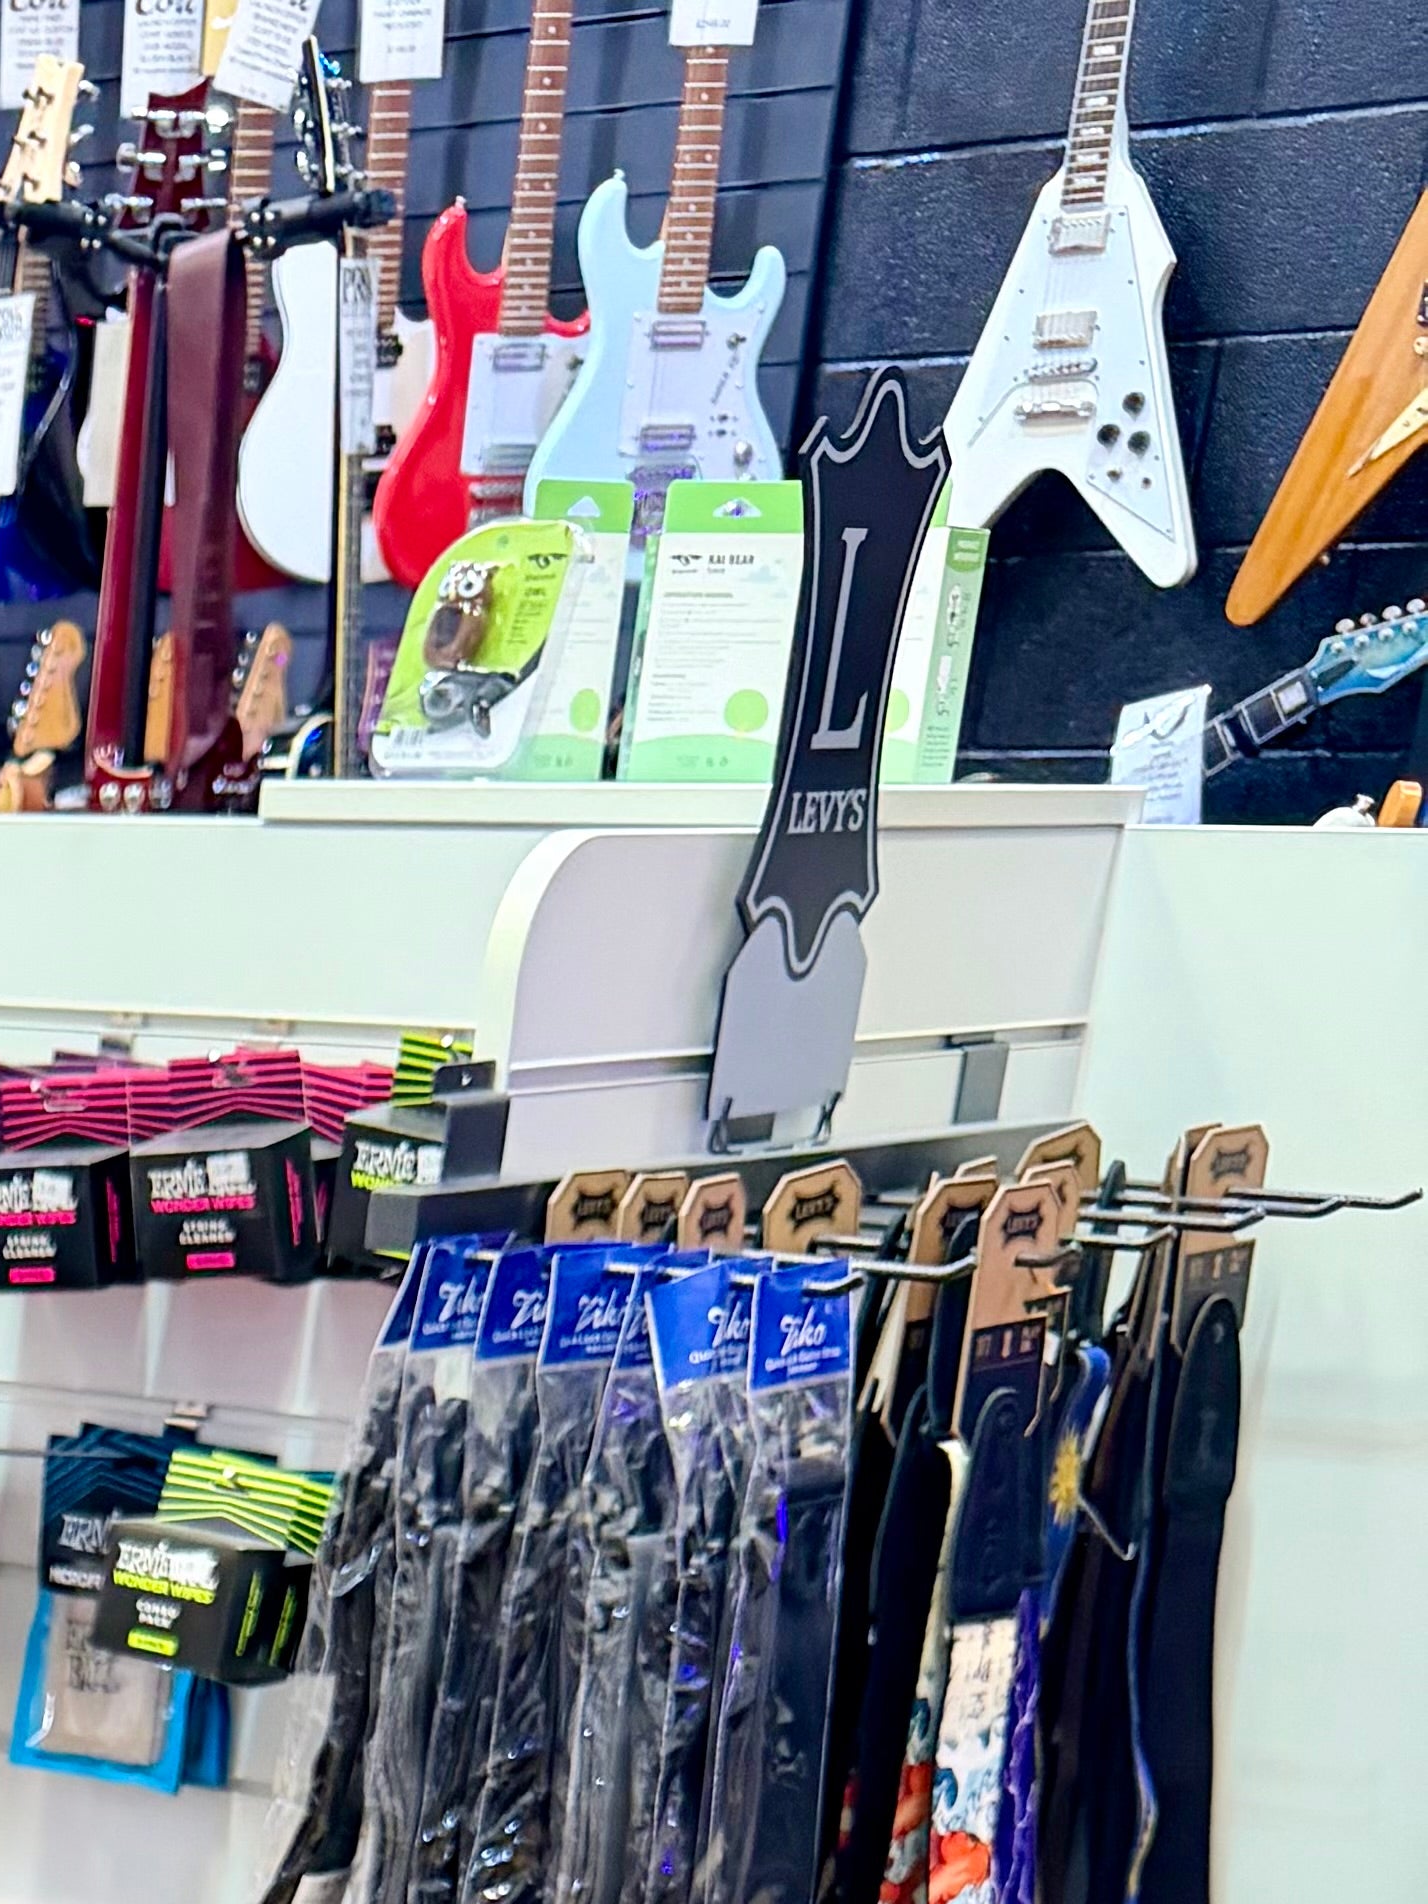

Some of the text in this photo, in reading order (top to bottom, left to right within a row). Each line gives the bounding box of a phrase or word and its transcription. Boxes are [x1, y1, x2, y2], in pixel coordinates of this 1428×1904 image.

[810, 527, 868, 749] L
[355, 1139, 417, 1179] ERNIE
[148, 1158, 207, 1199] ERNIE
[35, 1211, 76, 1226] WIPES
[151, 1195, 256, 1214] WONDER WIPES
[117, 1540, 169, 1576] ERNIE
[113, 1568, 216, 1605] WONDER WIPES
